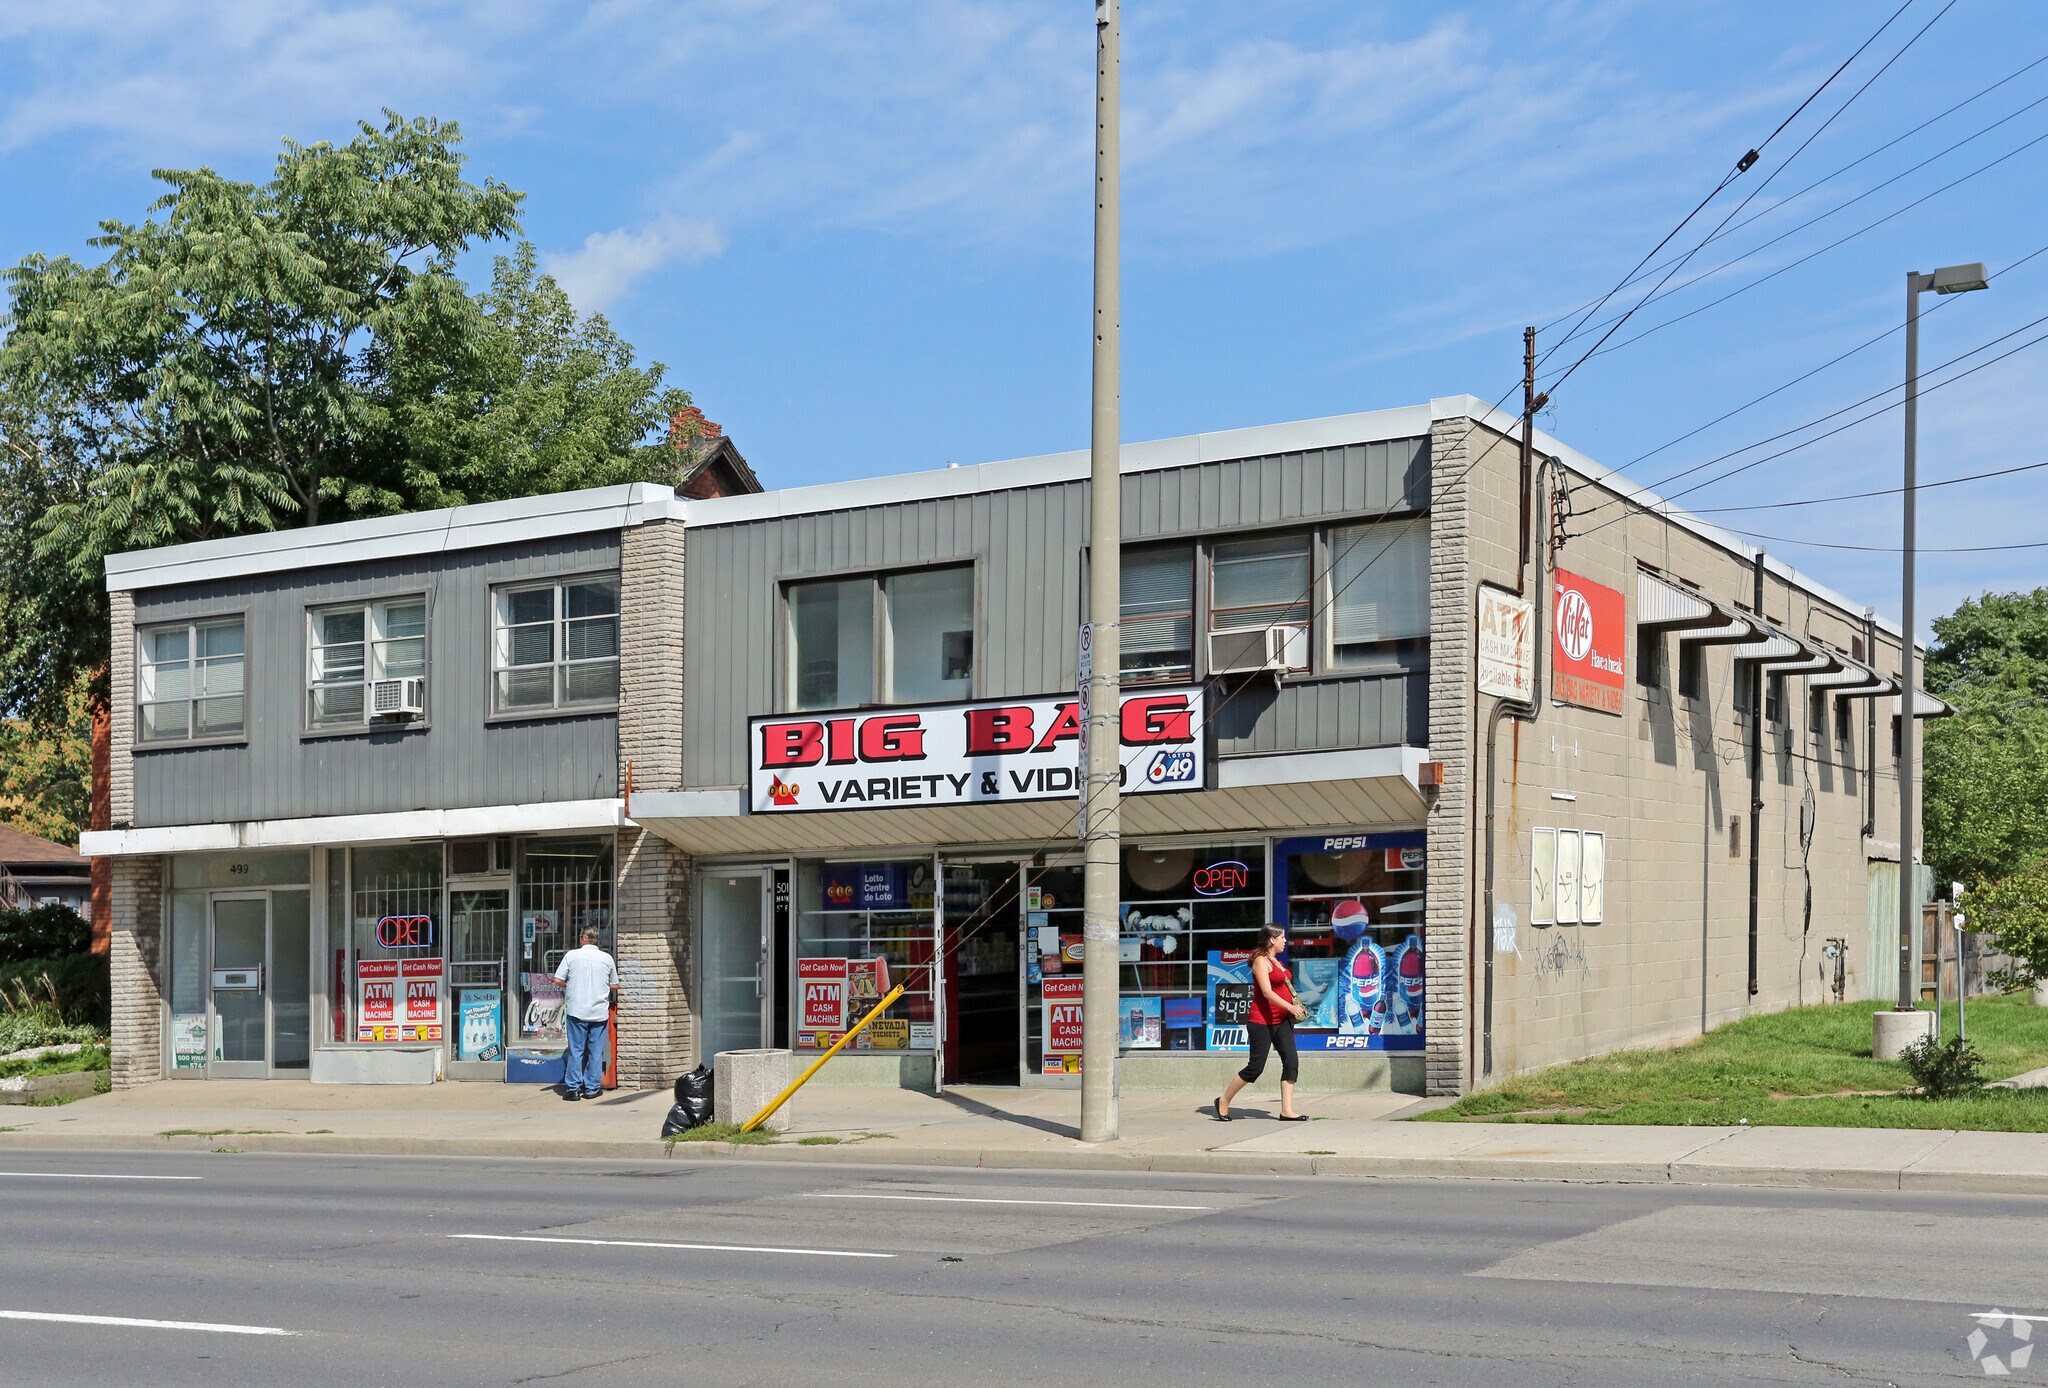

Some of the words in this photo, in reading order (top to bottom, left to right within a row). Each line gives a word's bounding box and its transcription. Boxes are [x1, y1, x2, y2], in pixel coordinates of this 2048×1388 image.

[1481, 598, 1530, 645] ATM
[1561, 595, 1590, 655] KitKat
[1481, 640, 1499, 655] CASH
[759, 714, 928, 770] BIG
[962, 694, 1196, 758] BAG
[1149, 753, 1193, 782] 649
[817, 772, 972, 803] VARIETY
[981, 771, 999, 794] &
[1009, 764, 1127, 793] VID
[768, 784, 799, 798] OLG
[1324, 836, 1367, 850] PEPSI
[1402, 851, 1424, 859] PEPS
[230, 864, 249, 875] 499
[864, 875, 884, 883] Lotto
[1193, 868, 1247, 889] OPEN
[776, 882, 789, 894] 501
[864, 883, 890, 892] Centre
[864, 893, 873, 901] de
[875, 893, 892, 901] Loto
[360, 965, 369, 973] Get
[370, 964, 383, 972] Cash
[384, 964, 397, 972] Now!
[800, 964, 812, 972] Get
[813, 964, 829, 972] Cash
[830, 963, 846, 972] Now!
[365, 984, 393, 998] ATM
[408, 983, 436, 997] ATM
[806, 985, 840, 1001] ATM
[1044, 984, 1056, 993] Get
[1059, 983, 1076, 992] Cash
[370, 1001, 387, 1009] CASH
[413, 1000, 430, 1008] CASH
[812, 1003, 833, 1012] CASH
[365, 1010, 393, 1019] MACHINE
[408, 1009, 436, 1018] MACHINE
[806, 1015, 840, 1024] MACHINE
[872, 1021, 906, 1031] NEVADA
[1059, 1026, 1082, 1035] CASH
[1052, 1038, 1083, 1047] MACHIN
[1212, 1030, 1250, 1046] MIL
[1326, 1036, 1369, 1048] PEPSI
